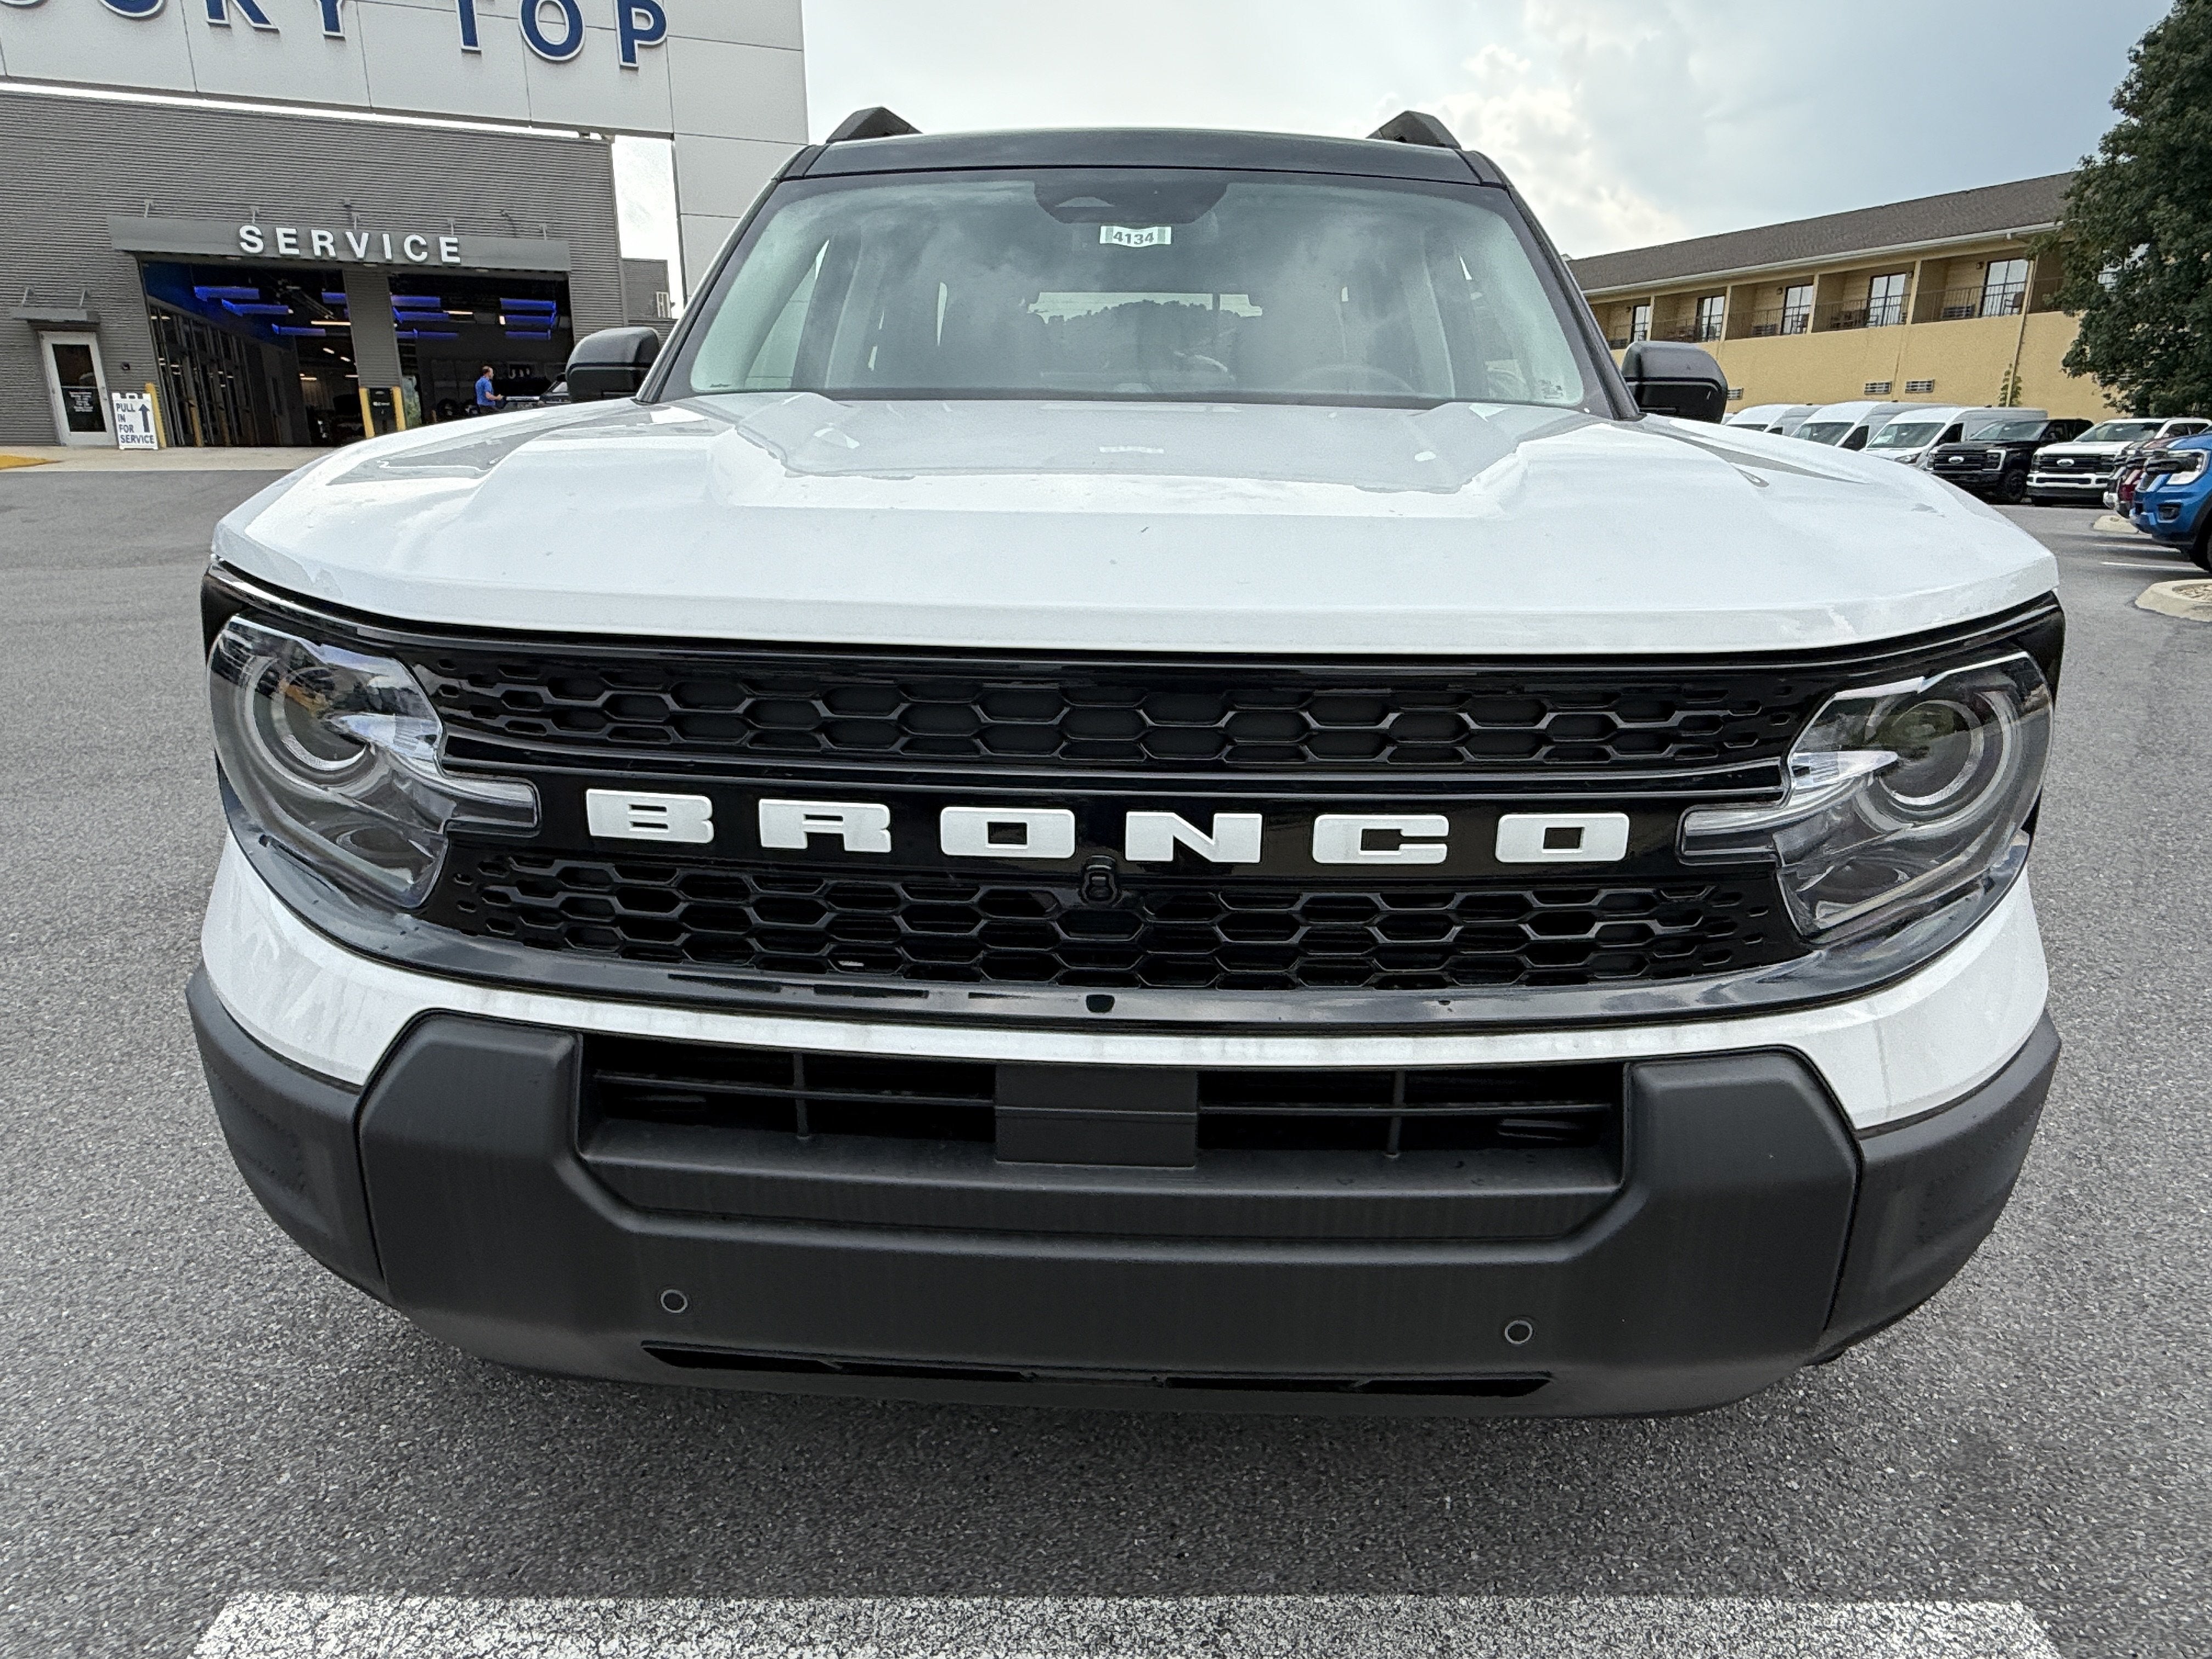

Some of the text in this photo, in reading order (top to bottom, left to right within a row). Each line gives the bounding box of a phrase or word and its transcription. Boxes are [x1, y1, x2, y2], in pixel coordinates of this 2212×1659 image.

[1113, 232, 1154, 245] 4134
[239, 225, 461, 264] SERVICE
[115, 403, 136, 413] PULL
[117, 414, 126, 422] IN
[119, 424, 134, 433] FOR
[120, 435, 155, 444] SERVICE
[586, 788, 1629, 865] BRONCO
